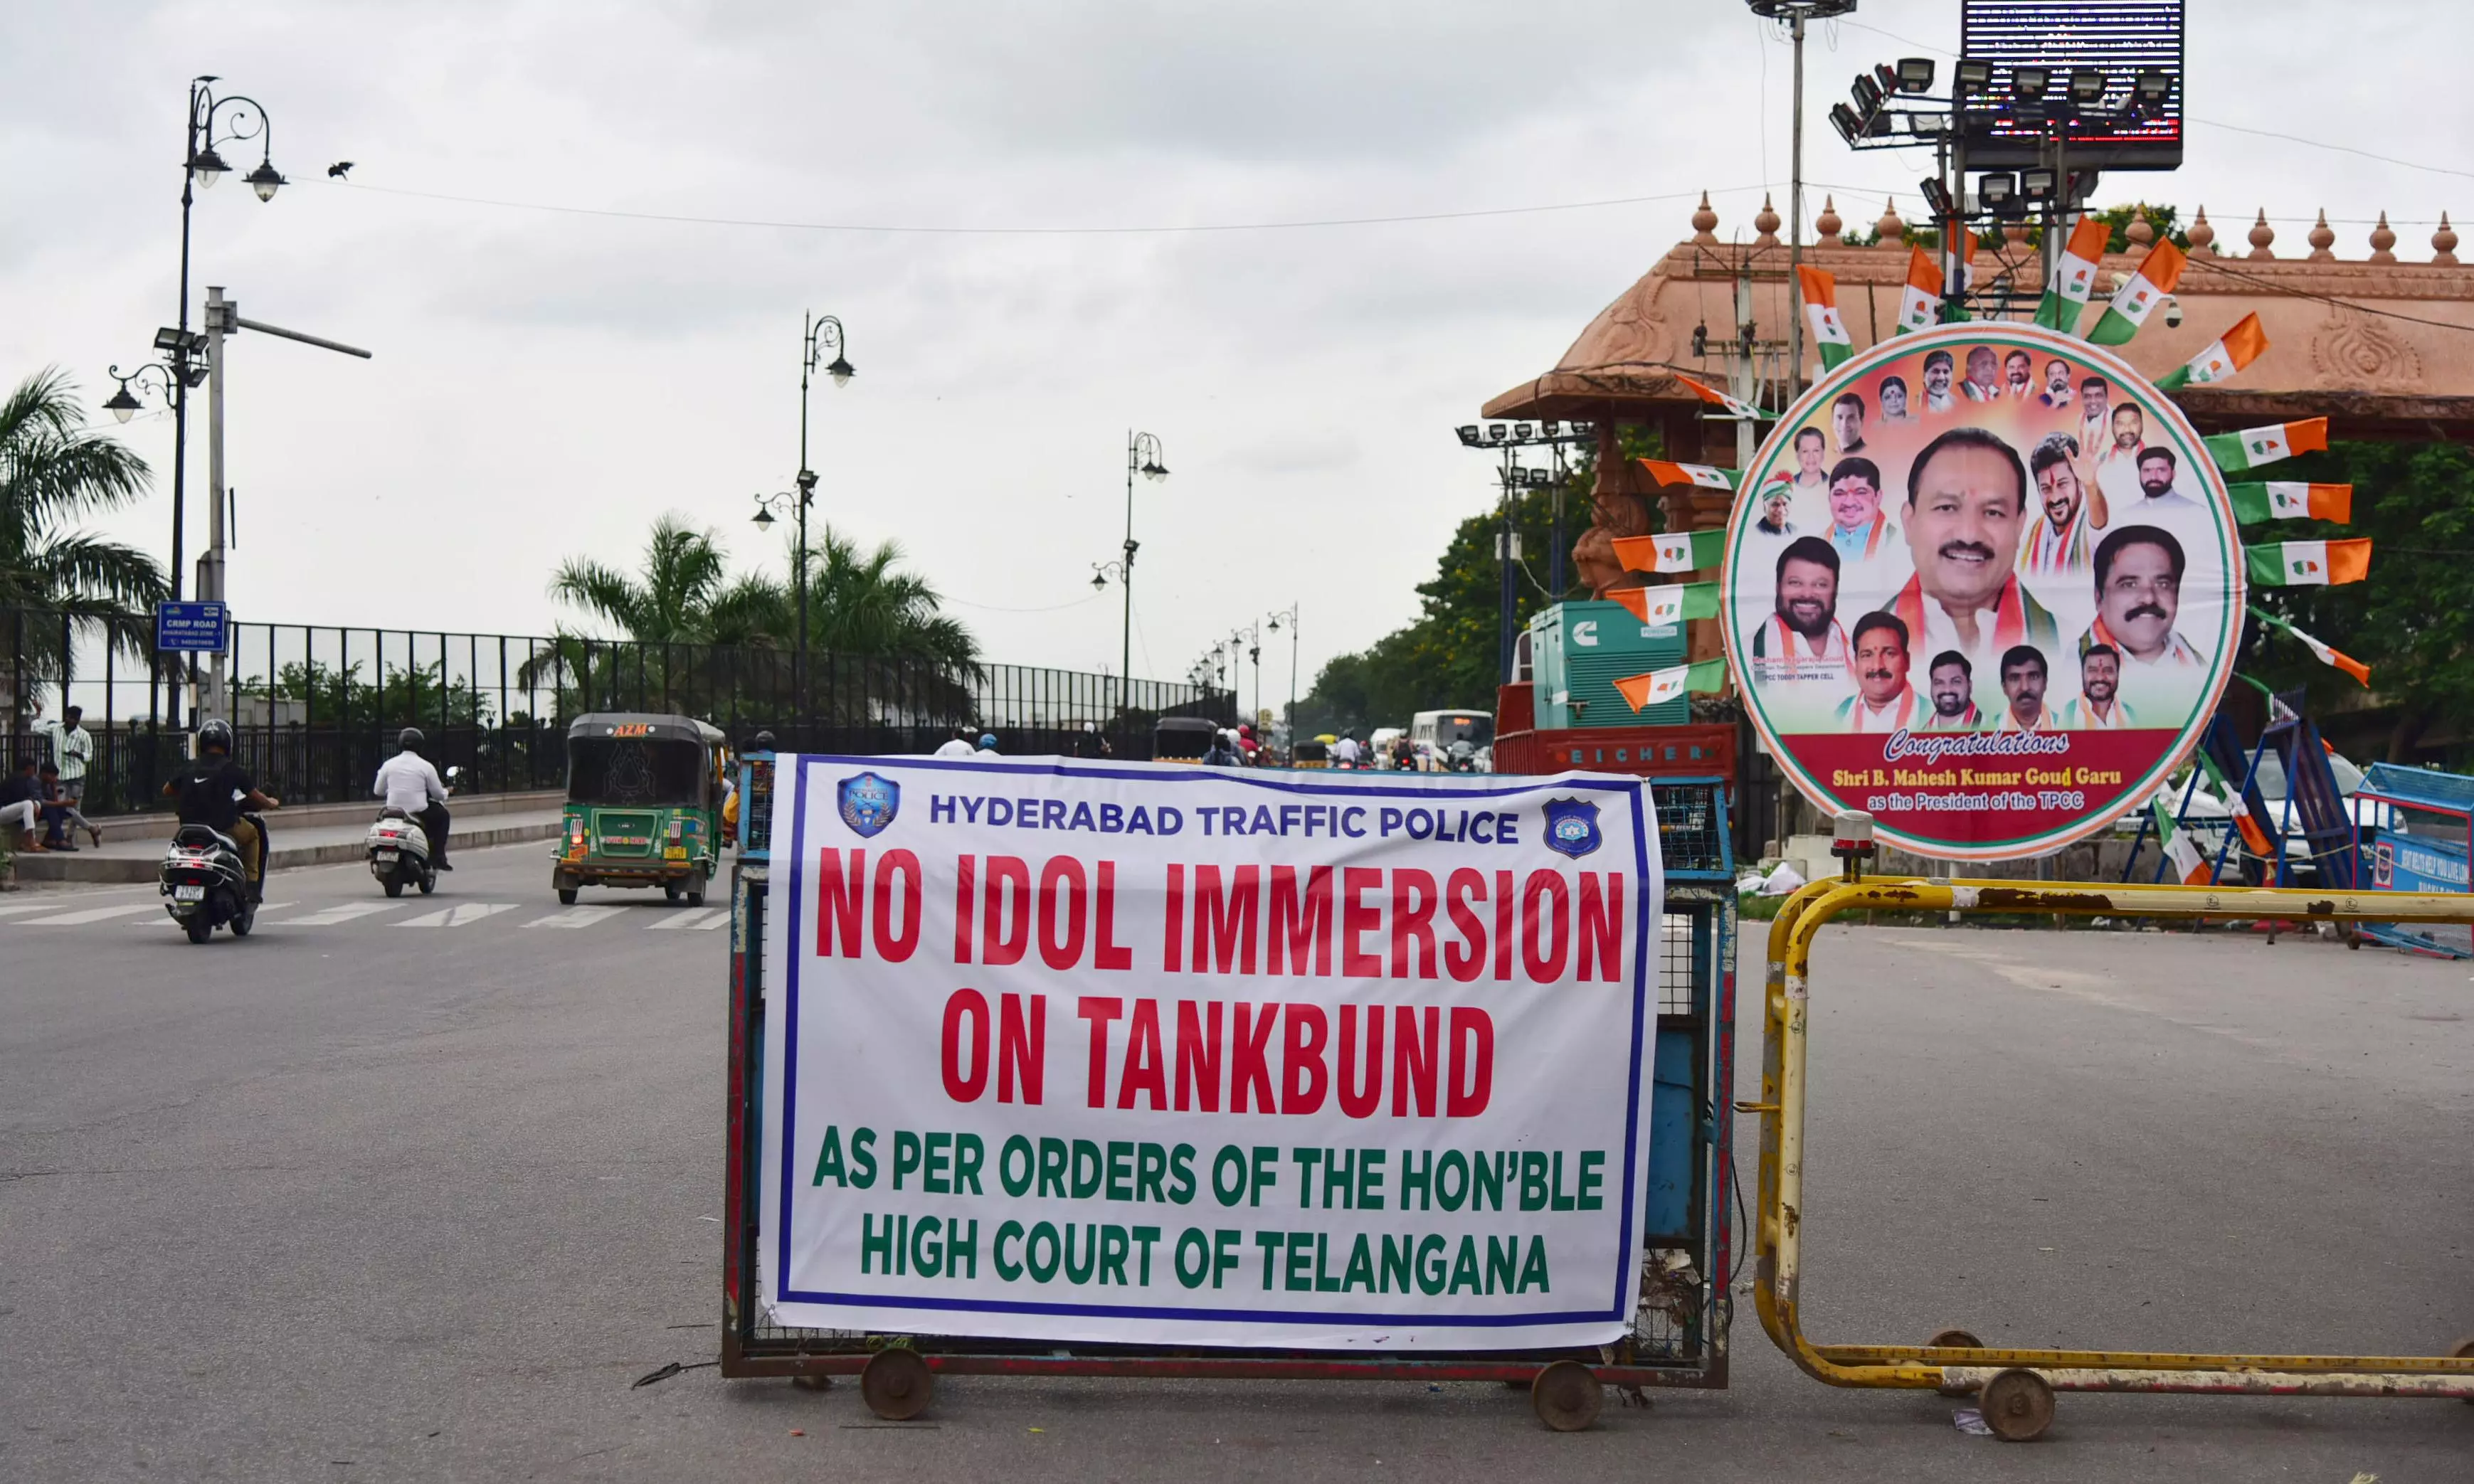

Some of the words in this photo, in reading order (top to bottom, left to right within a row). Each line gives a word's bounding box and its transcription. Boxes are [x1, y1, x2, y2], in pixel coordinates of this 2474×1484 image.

[1570, 745, 1703, 764] EICHER
[1883, 727, 2070, 765] Congratulations
[1833, 769, 1869, 787] Shri
[1873, 770, 1889, 786] B.
[1893, 768, 1957, 787] Mahesh
[1960, 768, 2021, 786] Kumar
[2026, 768, 2071, 787] Goud
[2075, 767, 2121, 785] Garu
[1868, 795, 1885, 810] as
[1887, 792, 1913, 810] the
[1915, 791, 1989, 810] President
[1992, 792, 2009, 810] of
[2009, 791, 2036, 810] the
[2038, 790, 2085, 810] TPCC
[931, 795, 1184, 836] HYDERABAD
[1196, 804, 1368, 839] TRAFFIC
[1380, 807, 1520, 845] POLICE
[816, 847, 923, 964] NO
[954, 854, 1133, 972] IDOL
[1163, 862, 1624, 985] IMMERSION
[941, 987, 1047, 1106] ON
[1077, 996, 1495, 1120] TANKBUND
[813, 1125, 877, 1189] AS
[894, 1130, 985, 1195] PER
[1000, 1135, 1197, 1204] ORDERS
[1212, 1145, 1279, 1207] OF
[1293, 1148, 1386, 1210] THE
[1400, 1149, 1605, 1212] HON'BLE
[862, 1214, 978, 1280] HIGH
[993, 1220, 1161, 1286] COURT
[1175, 1227, 1242, 1288] OF
[1256, 1231, 1550, 1295] TELANGANA
